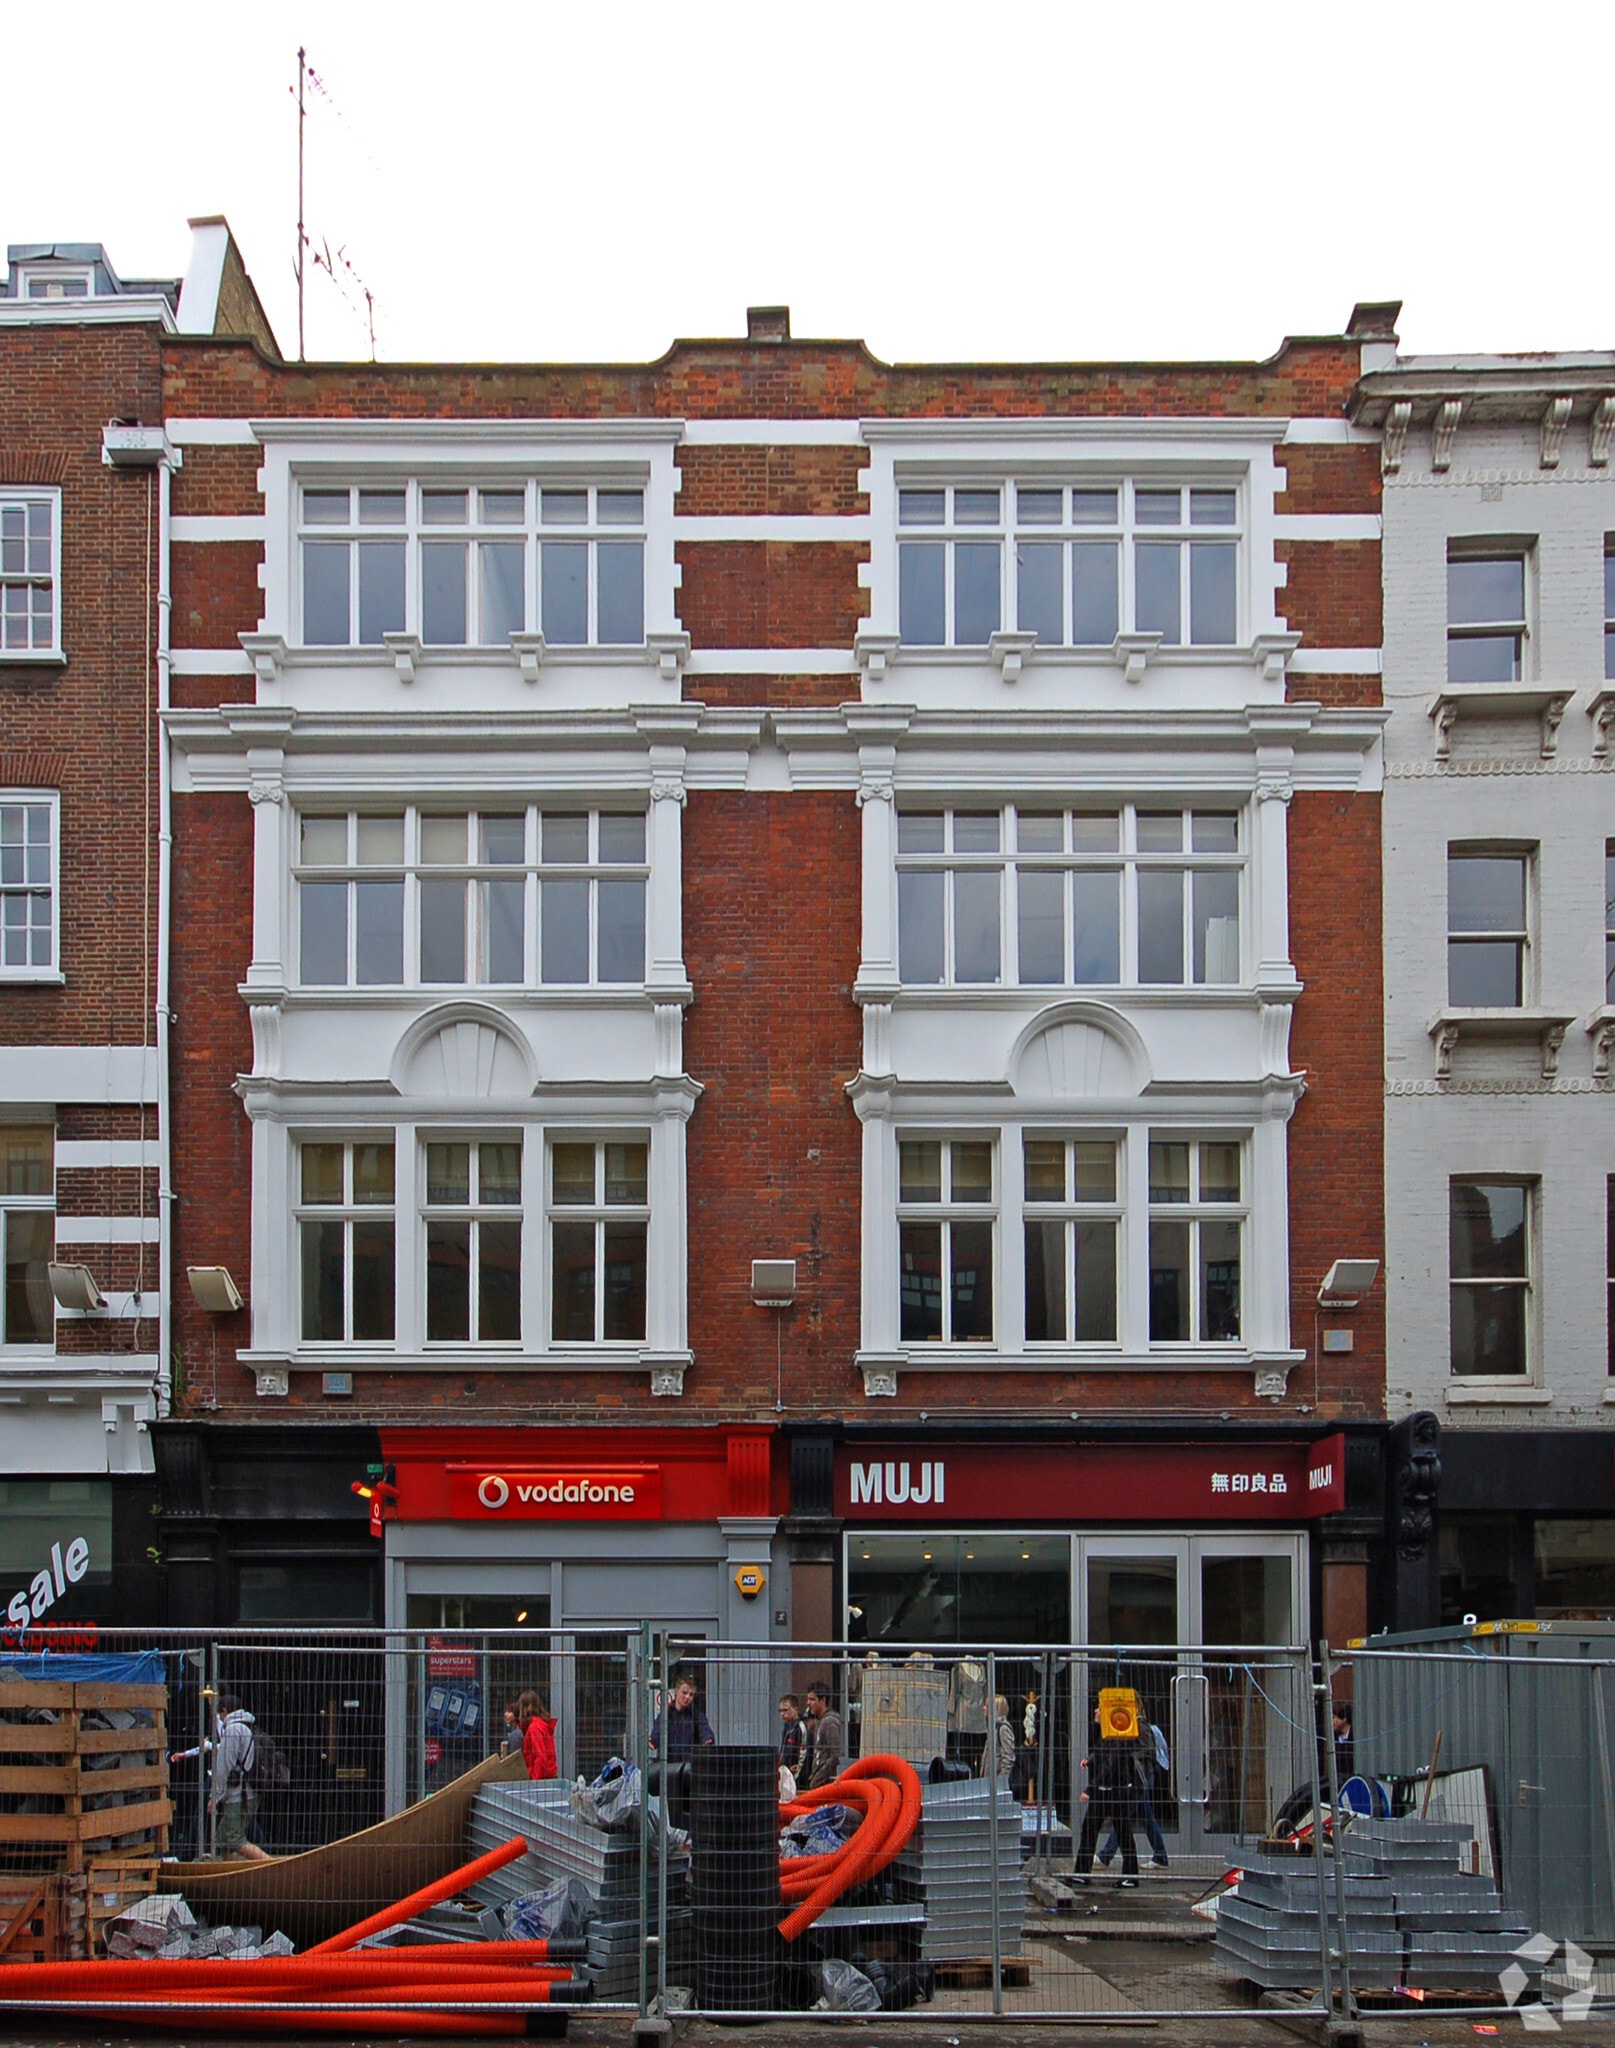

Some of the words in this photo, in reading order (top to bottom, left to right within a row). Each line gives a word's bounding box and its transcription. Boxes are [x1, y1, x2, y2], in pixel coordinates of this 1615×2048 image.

[850, 1462, 945, 1504] MUJI
[1211, 1472, 1287, 1493] 無印良品
[1309, 1464, 1332, 1491] MUJI
[516, 1479, 635, 1503] vodafone
[8, 1537, 90, 1629] sale
[743, 1576, 757, 1584] ADT
